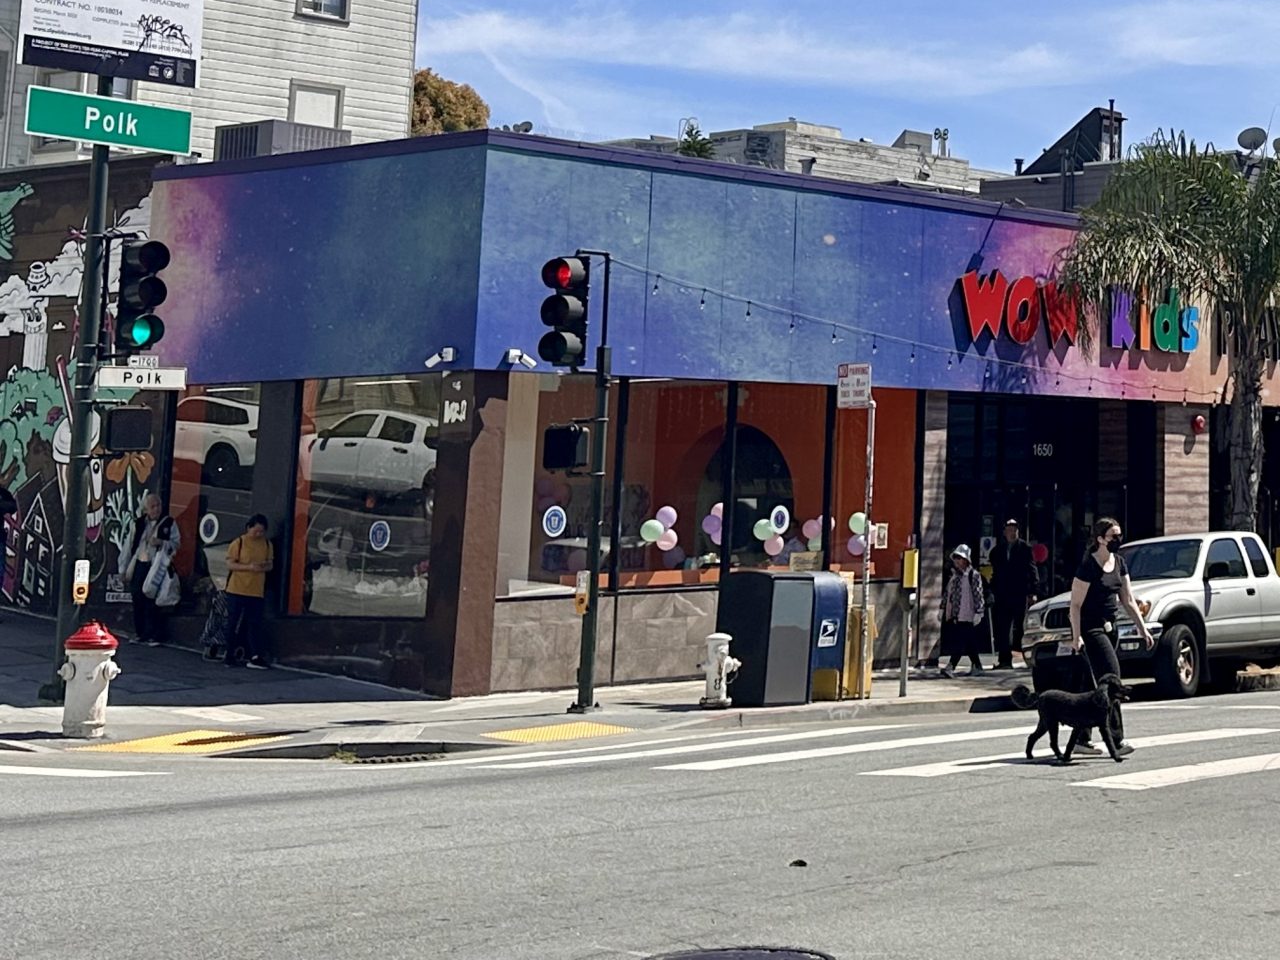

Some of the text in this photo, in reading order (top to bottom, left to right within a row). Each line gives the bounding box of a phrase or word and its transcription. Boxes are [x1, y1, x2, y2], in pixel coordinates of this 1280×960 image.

[84, 106, 138, 137] Polk
[960, 268, 1081, 350] WOW
[123, 371, 162, 384] Polk
[1033, 444, 1053, 456] 1650
